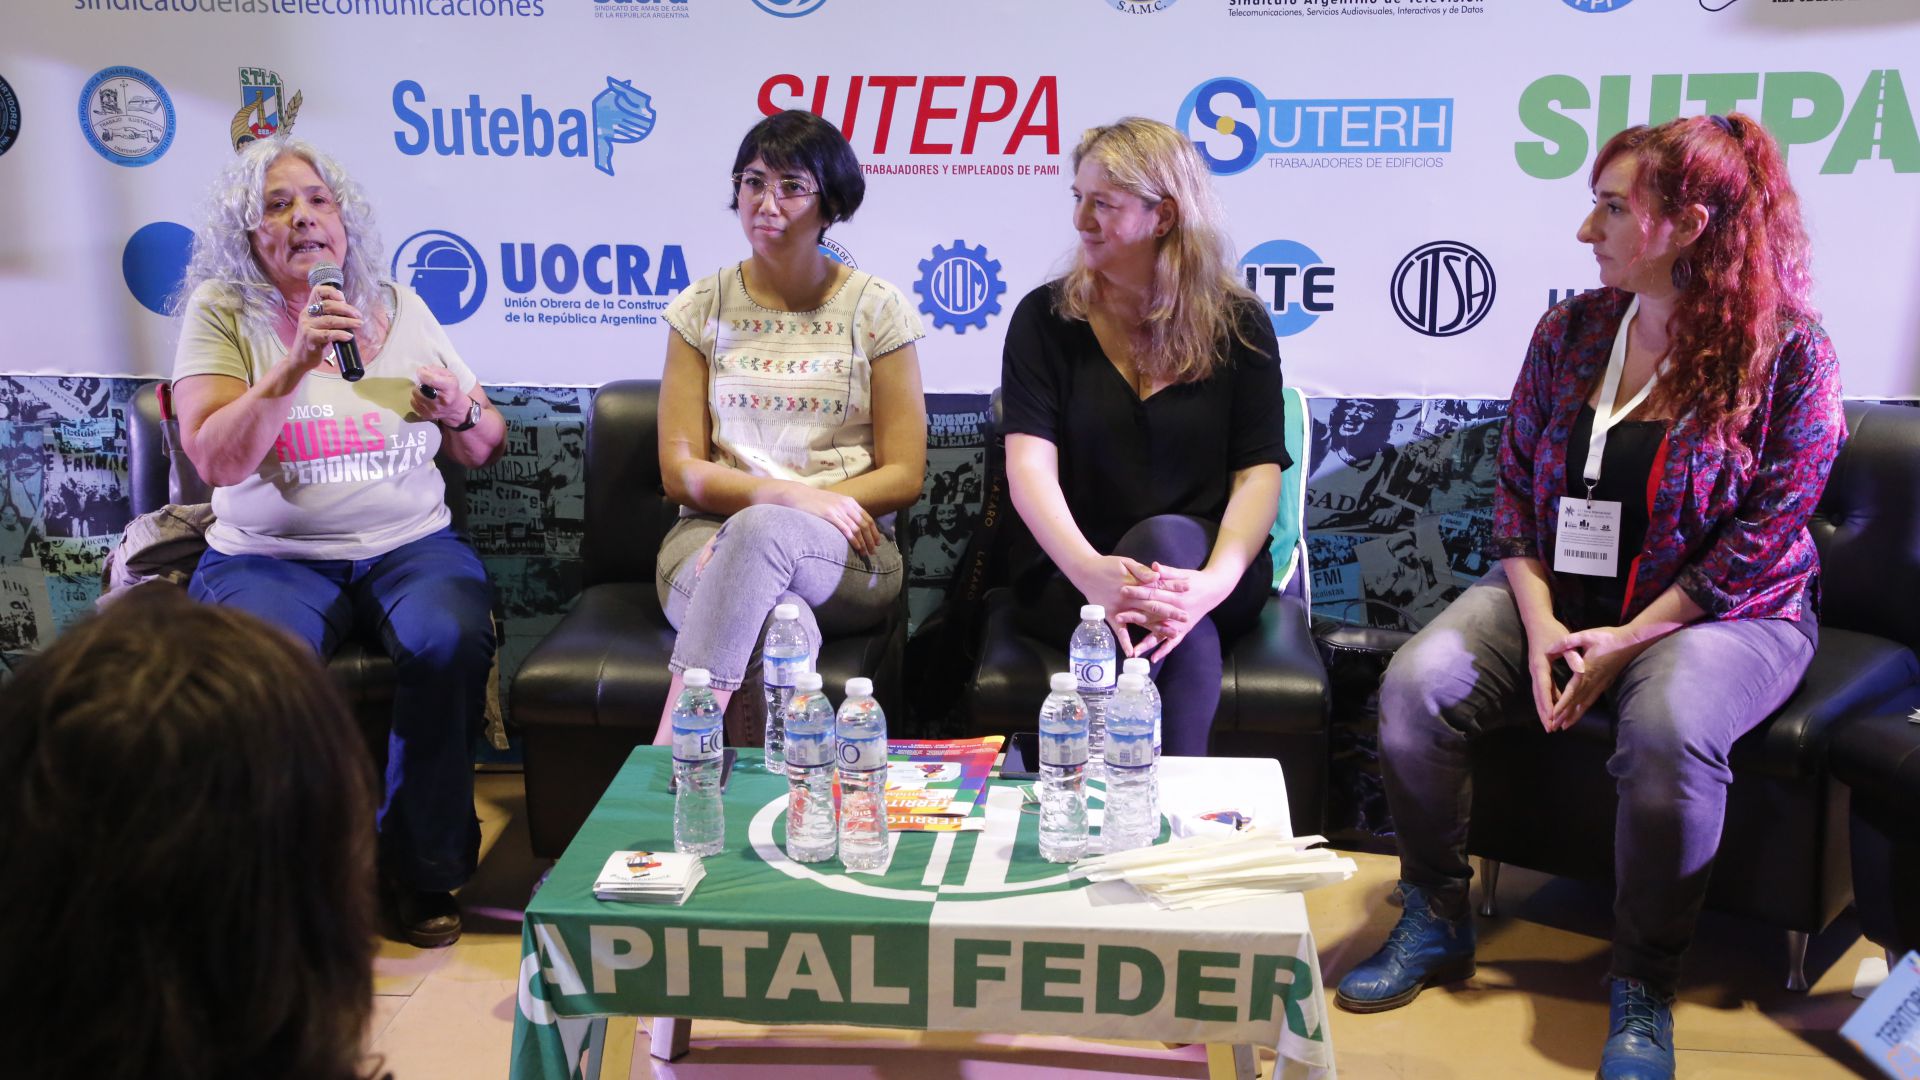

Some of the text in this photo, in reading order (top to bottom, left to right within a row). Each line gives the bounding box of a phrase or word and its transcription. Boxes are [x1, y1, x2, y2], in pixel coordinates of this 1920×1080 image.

[1228, 6, 1484, 17] Telecomunicaciones, Servicios Audiovisuales, Interactivos y de Datos
[392, 79, 588, 157] Suteba
[756, 74, 1060, 155] SUTEPA
[859, 164, 1060, 176] TRABAJADORES Y EMPLEADOS DE PAMI
[1268, 157, 1444, 169] TRABAJADORES DE EDIFICIOS
[500, 242, 691, 296] UOCRA
[504, 296, 537, 308] Unión
[540, 297, 581, 309] Obrera
[584, 298, 600, 309] de
[603, 298, 614, 309] la
[504, 311, 657, 327] de la República Argentina
[287, 404, 335, 420] OMOS
[389, 430, 427, 449] LAS
[1313, 567, 1343, 588] FMI
